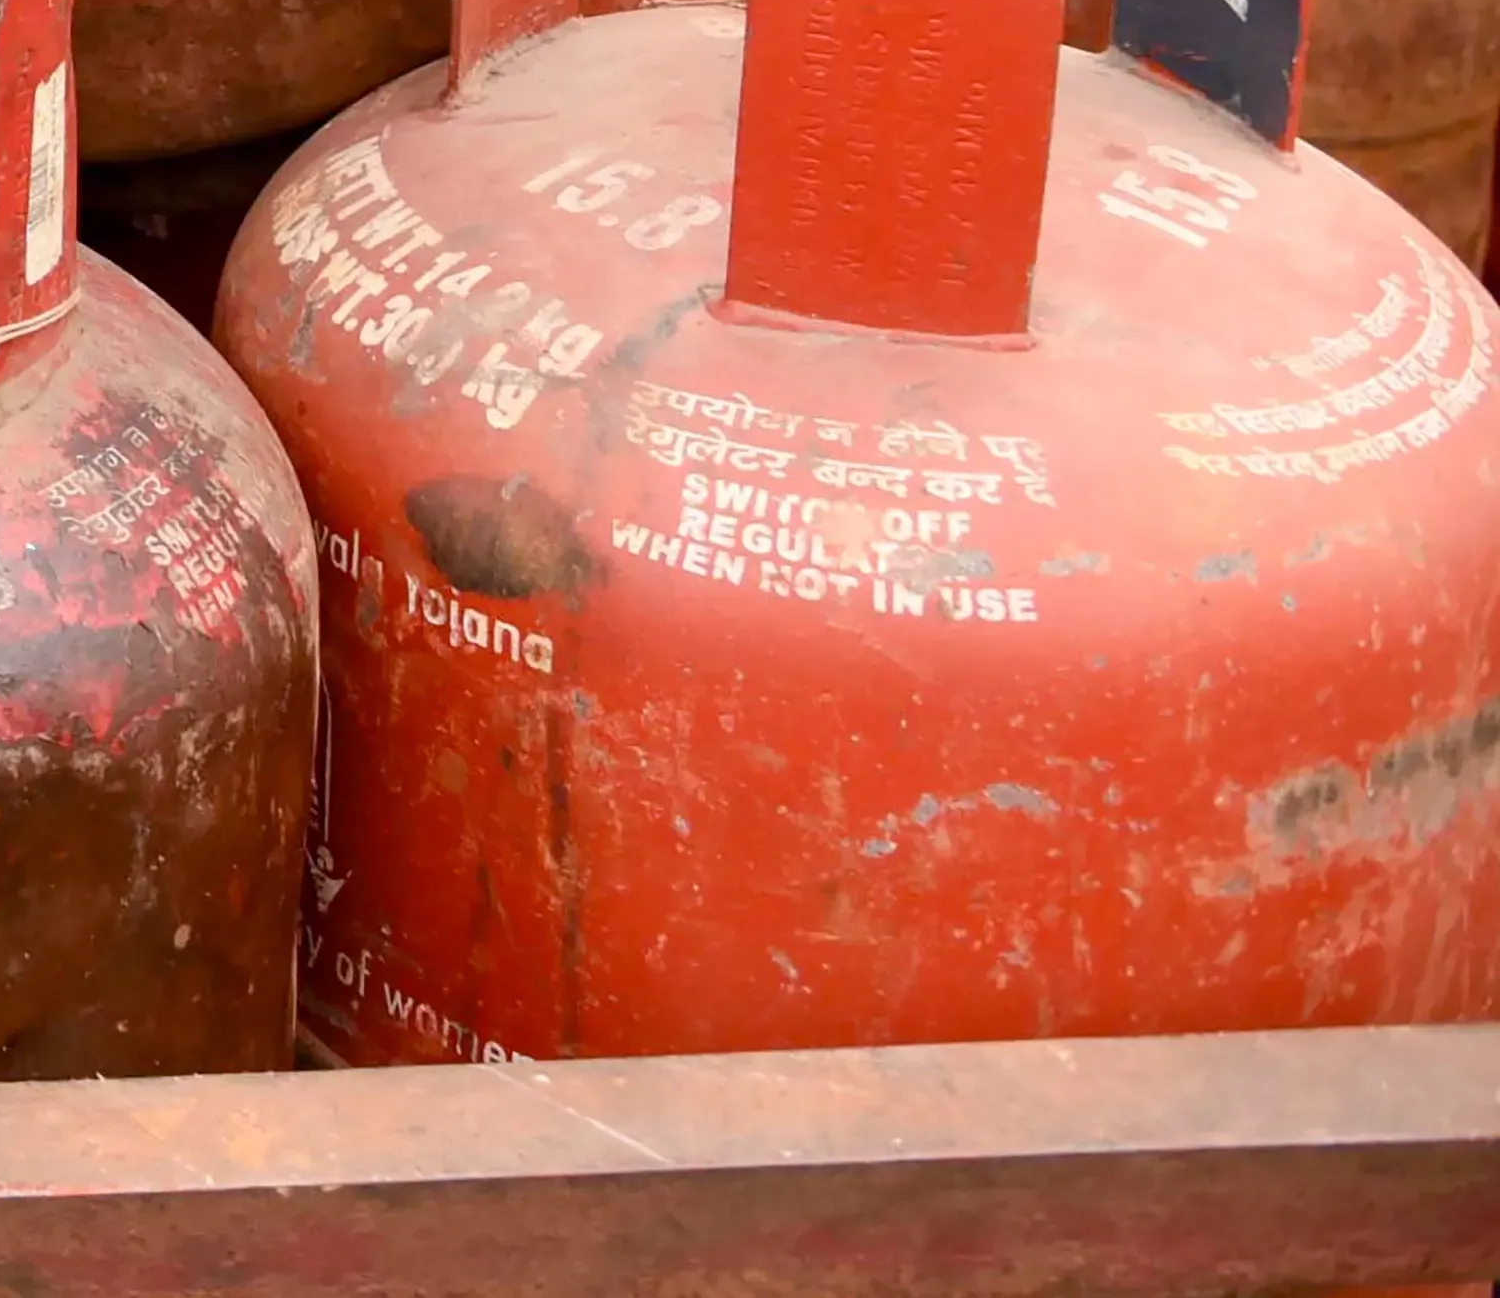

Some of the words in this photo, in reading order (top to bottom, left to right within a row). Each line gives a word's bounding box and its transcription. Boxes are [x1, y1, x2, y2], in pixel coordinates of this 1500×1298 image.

[520, 159, 722, 252] 15.8
[680, 473, 866, 527] SWITC
[881, 509, 973, 543] OFF
[920, 468, 1004, 507] कर
[610, 519, 748, 587] WHEN
[756, 558, 859, 603] NOT
[871, 579, 926, 619] IN
[937, 585, 1040, 624] USE
[404, 570, 554, 674] Yojana
[335, 947, 372, 997] of
